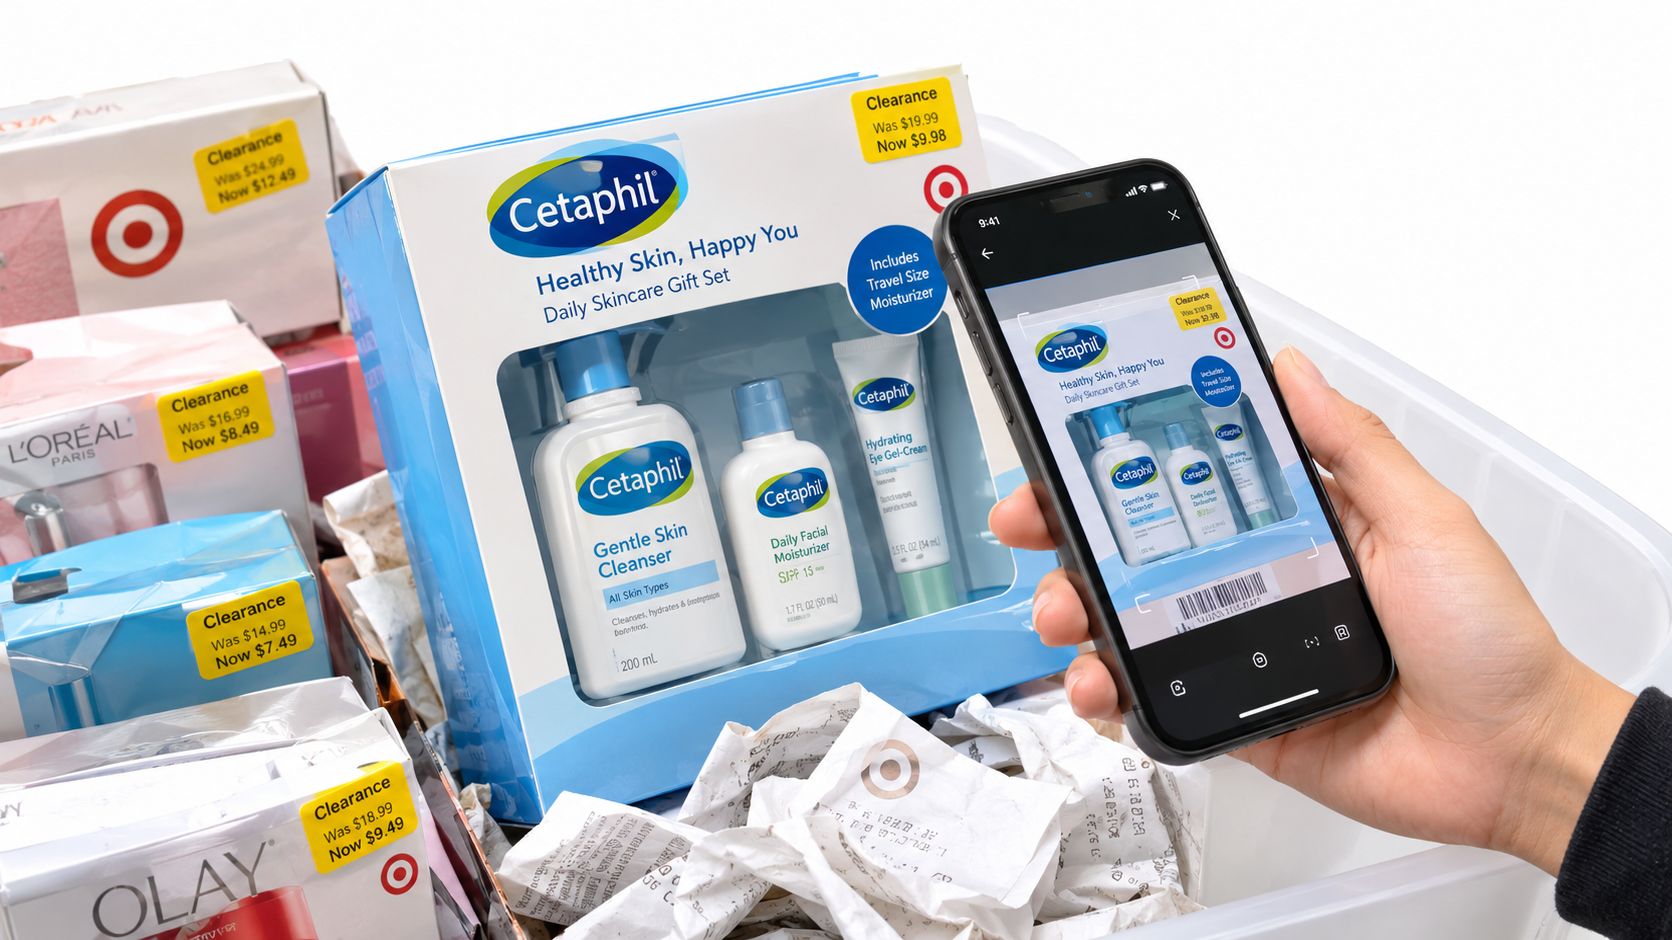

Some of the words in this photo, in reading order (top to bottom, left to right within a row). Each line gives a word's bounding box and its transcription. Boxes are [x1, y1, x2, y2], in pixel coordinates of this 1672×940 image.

[866, 88, 938, 110] Clearance
[872, 122, 898, 134] Was
[900, 112, 939, 130] $19.99
[207, 132, 283, 165] Clearance
[876, 138, 907, 153] Now
[911, 129, 946, 149] $9.98
[214, 172, 241, 186] Was
[243, 153, 284, 177] $24.99
[218, 186, 249, 204] Now
[252, 167, 296, 193] $12.49
[509, 170, 659, 233] Cetaphil
[978, 216, 1001, 228] 9:41
[536, 260, 623, 295] Healthy
[629, 247, 683, 272] Skin,
[688, 231, 757, 260] Happy
[759, 224, 799, 243] You
[870, 252, 919, 271] Includes
[866, 276, 903, 292] Travel
[905, 269, 930, 282] Size
[543, 300, 588, 323] Daily
[592, 284, 664, 311] Skincare
[667, 270, 700, 294] Gift
[702, 268, 731, 286] Set
[870, 287, 934, 310] Moisturizer
[1043, 336, 1101, 362] Cetaphil
[1059, 376, 1093, 391] Healthy
[1117, 362, 1147, 376] Happy
[1147, 358, 1165, 368] You
[172, 382, 249, 413] Clearance
[858, 383, 909, 405] Cetaphil
[1064, 392, 1083, 404] Daily
[178, 420, 206, 435] Was
[208, 406, 250, 428] $16.99
[8, 420, 133, 464] L'ORÉAL
[182, 434, 215, 453] Now
[220, 421, 260, 443] $8.49
[865, 433, 913, 450] Hydrating
[51, 448, 96, 467] PARIS
[869, 454, 883, 464] Eye
[884, 444, 928, 461] Gel-Cream
[589, 457, 684, 499] Cetaphil
[764, 479, 823, 507] Cetaphil
[593, 534, 650, 558] Gentle
[655, 523, 688, 543] Skin
[770, 534, 798, 549] Daily
[800, 525, 828, 542] Facial
[598, 549, 672, 578] Cleanser
[774, 541, 830, 564] Moisturizer
[804, 565, 814, 577] 15
[609, 594, 620, 604] All
[623, 588, 642, 600] Skin
[644, 582, 669, 596] Types
[203, 596, 286, 629] Clearance
[648, 603, 680, 617] hydrates
[786, 604, 795, 614] 1.7
[211, 636, 240, 651] Was
[243, 619, 286, 642] $14.99
[216, 650, 250, 669] Now
[255, 634, 297, 658] $7.49
[621, 658, 639, 672] 200
[314, 778, 391, 820] Clearance
[323, 826, 351, 843] Was
[353, 802, 392, 830] $18.99
[329, 839, 361, 862] Now
[366, 816, 404, 845] $9.49
[92, 841, 266, 937] OLAY
